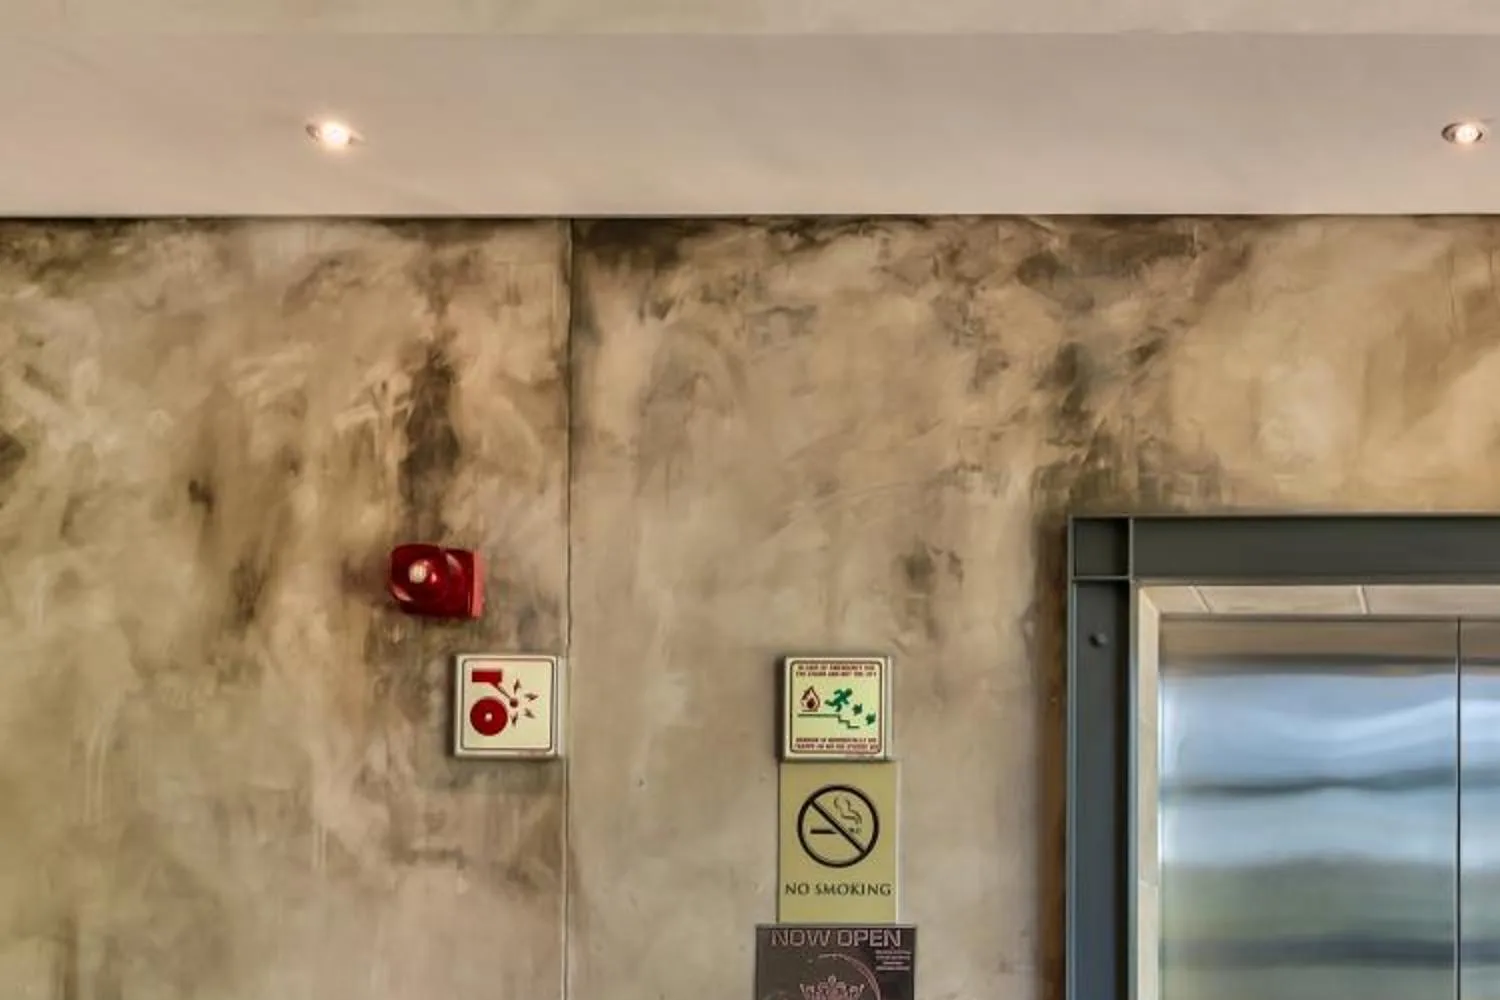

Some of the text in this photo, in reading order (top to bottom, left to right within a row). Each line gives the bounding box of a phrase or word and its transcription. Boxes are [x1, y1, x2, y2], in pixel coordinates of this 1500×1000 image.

[785, 882, 892, 896] NO SMOKING
[771, 929, 901, 947] NOW OPEN
